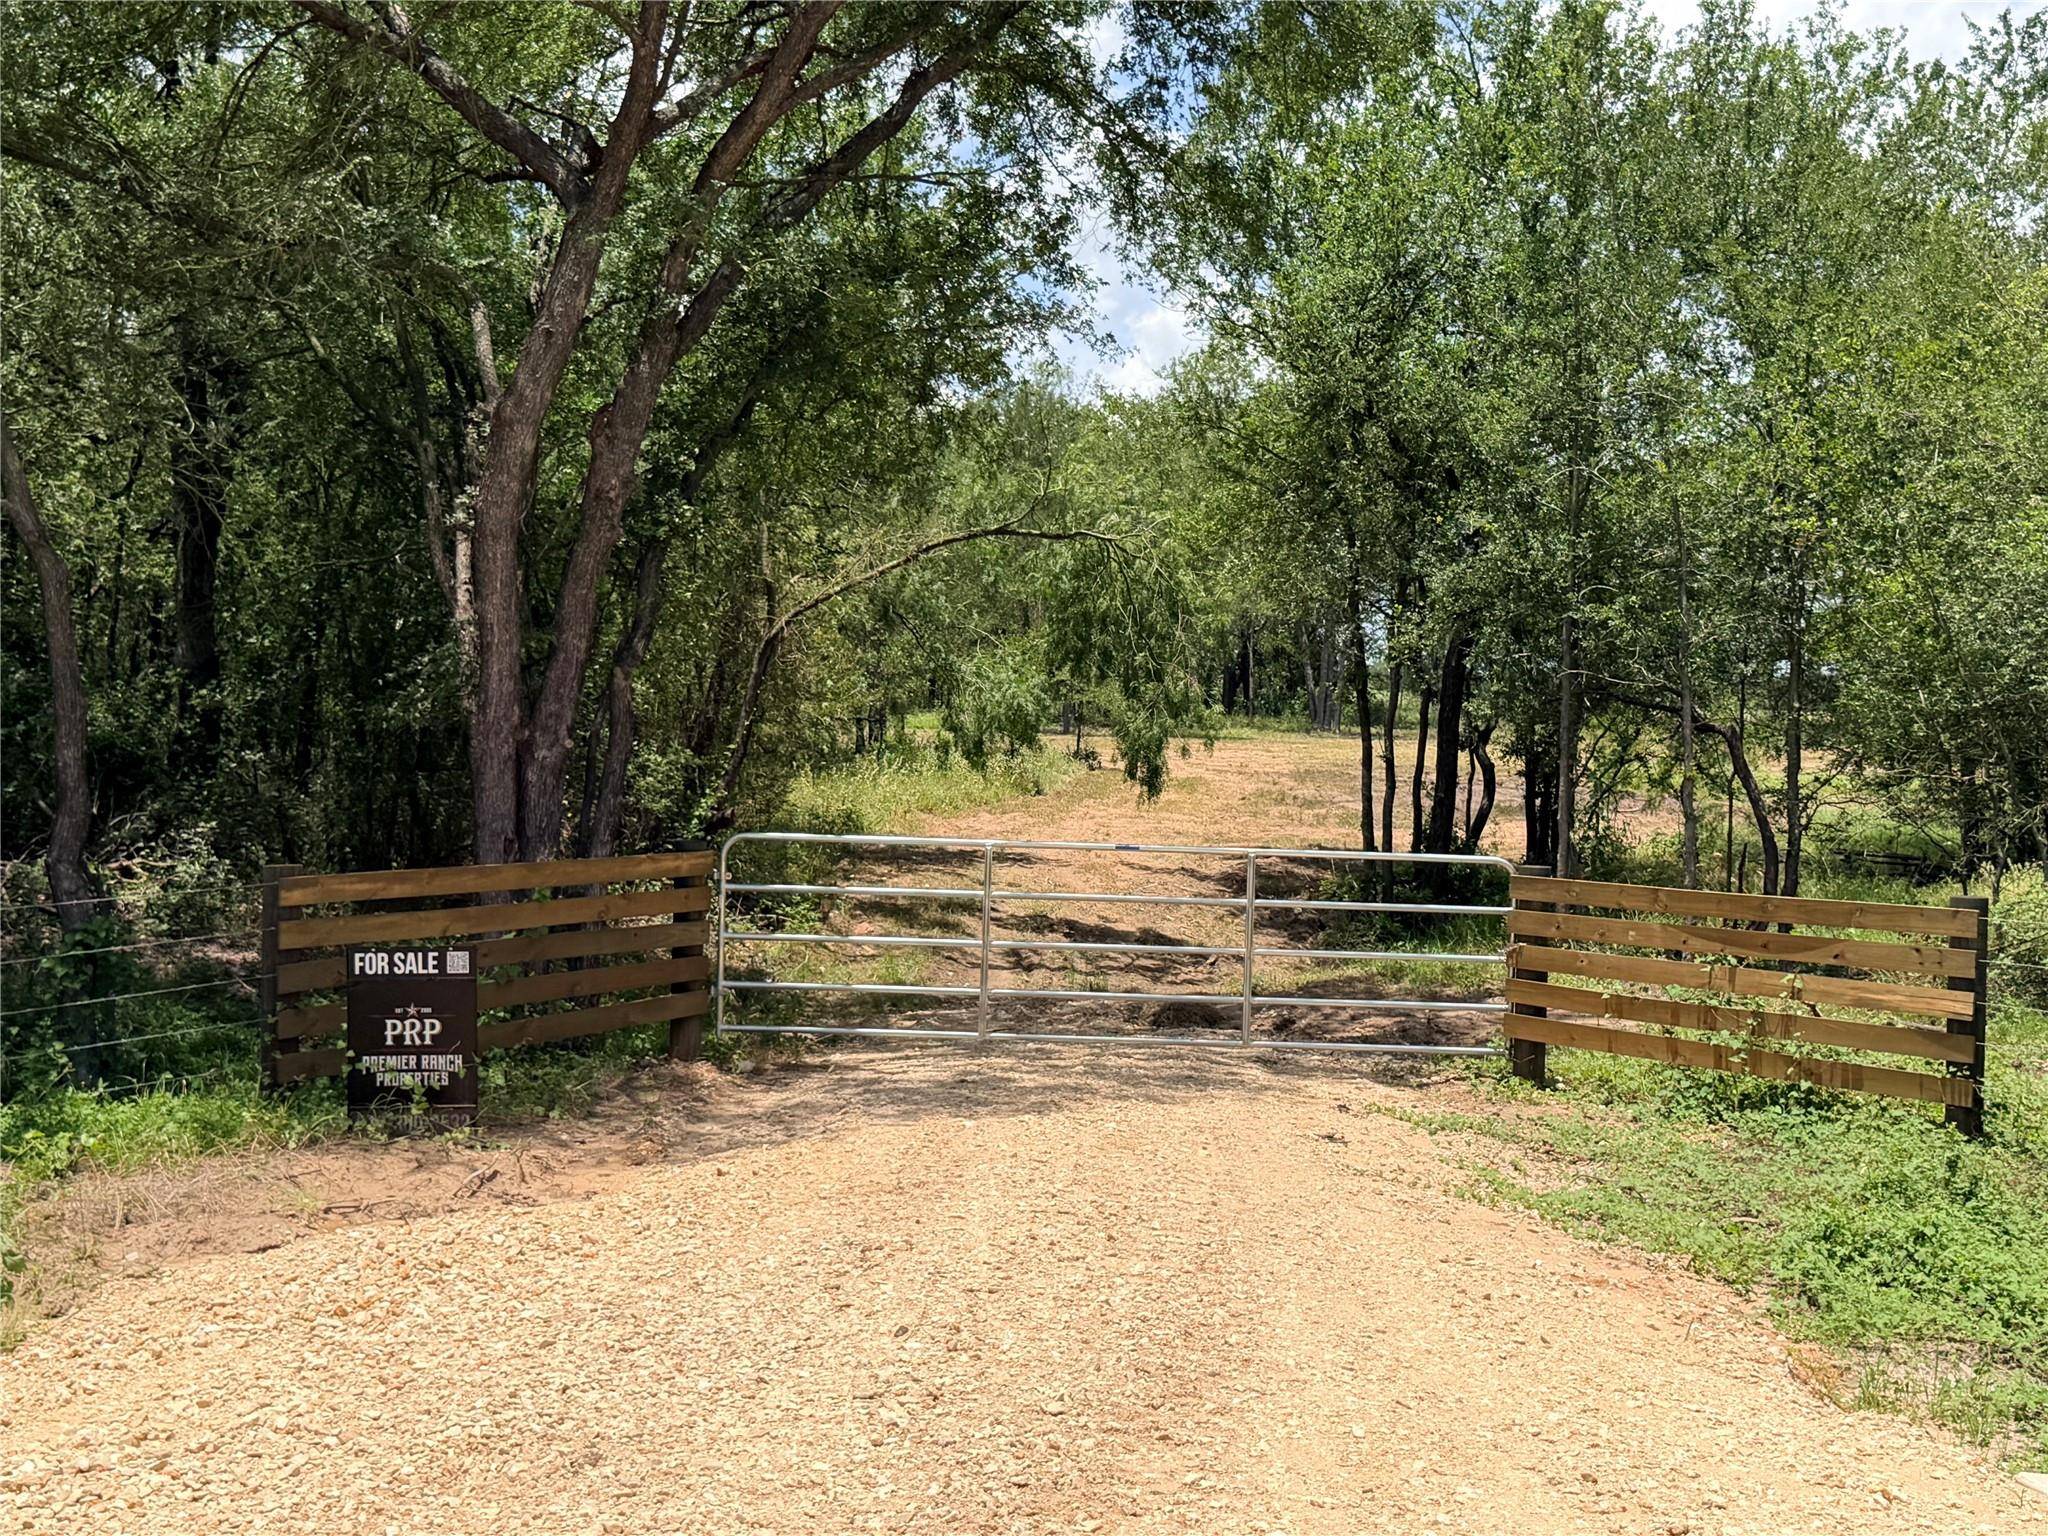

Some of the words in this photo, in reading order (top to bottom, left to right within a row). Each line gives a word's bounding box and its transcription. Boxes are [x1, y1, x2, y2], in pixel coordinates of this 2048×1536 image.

[354, 952, 389, 975] FOR
[393, 952, 439, 975] SALE
[384, 1018, 443, 1046] PRP
[362, 1055, 417, 1075] PREMIER
[421, 1054, 463, 1072] RANCH
